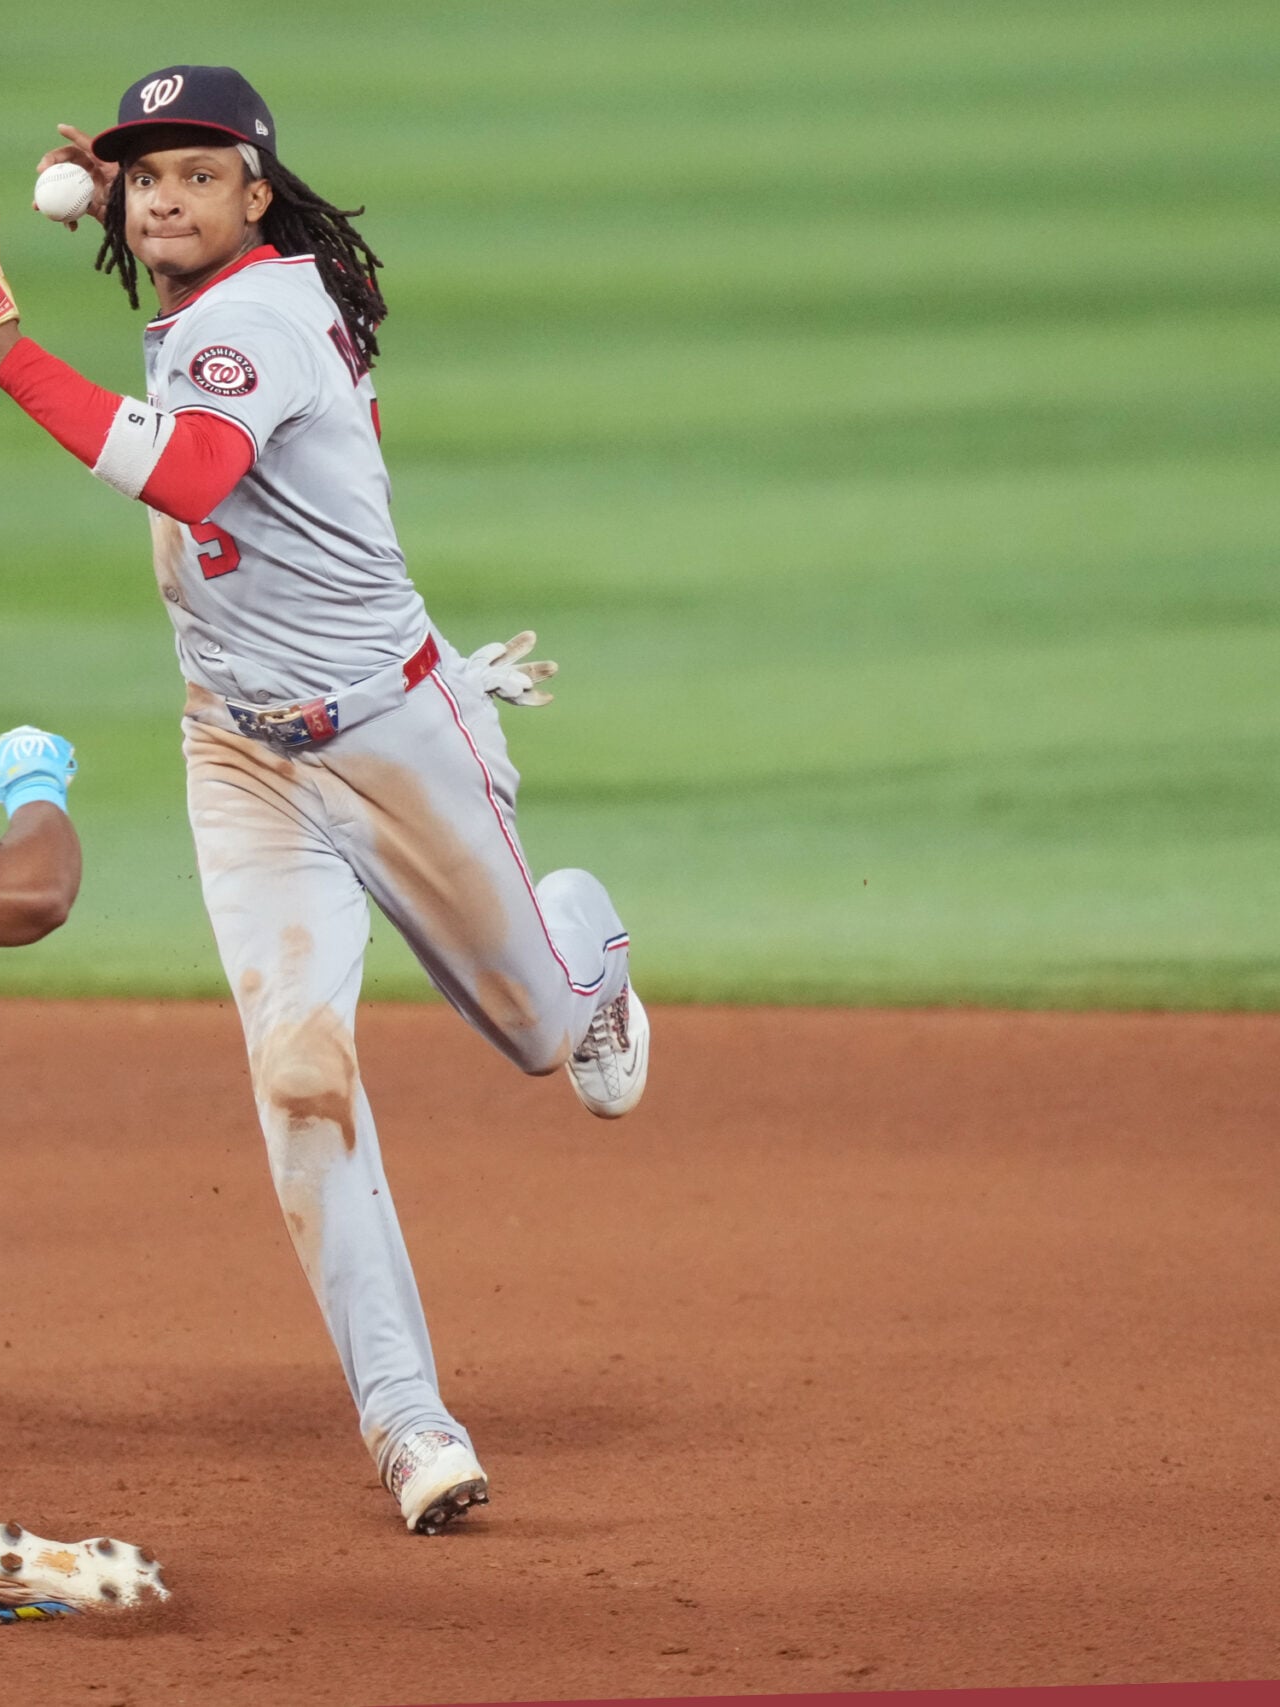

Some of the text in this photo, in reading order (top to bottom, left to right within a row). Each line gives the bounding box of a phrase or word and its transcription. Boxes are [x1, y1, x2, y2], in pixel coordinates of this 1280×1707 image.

[140, 74, 184, 114] W
[196, 347, 255, 379] WASHINGTON
[208, 362, 240, 385] W
[194, 374, 249, 396] NATIONALS
[128, 413, 146, 426] 5
